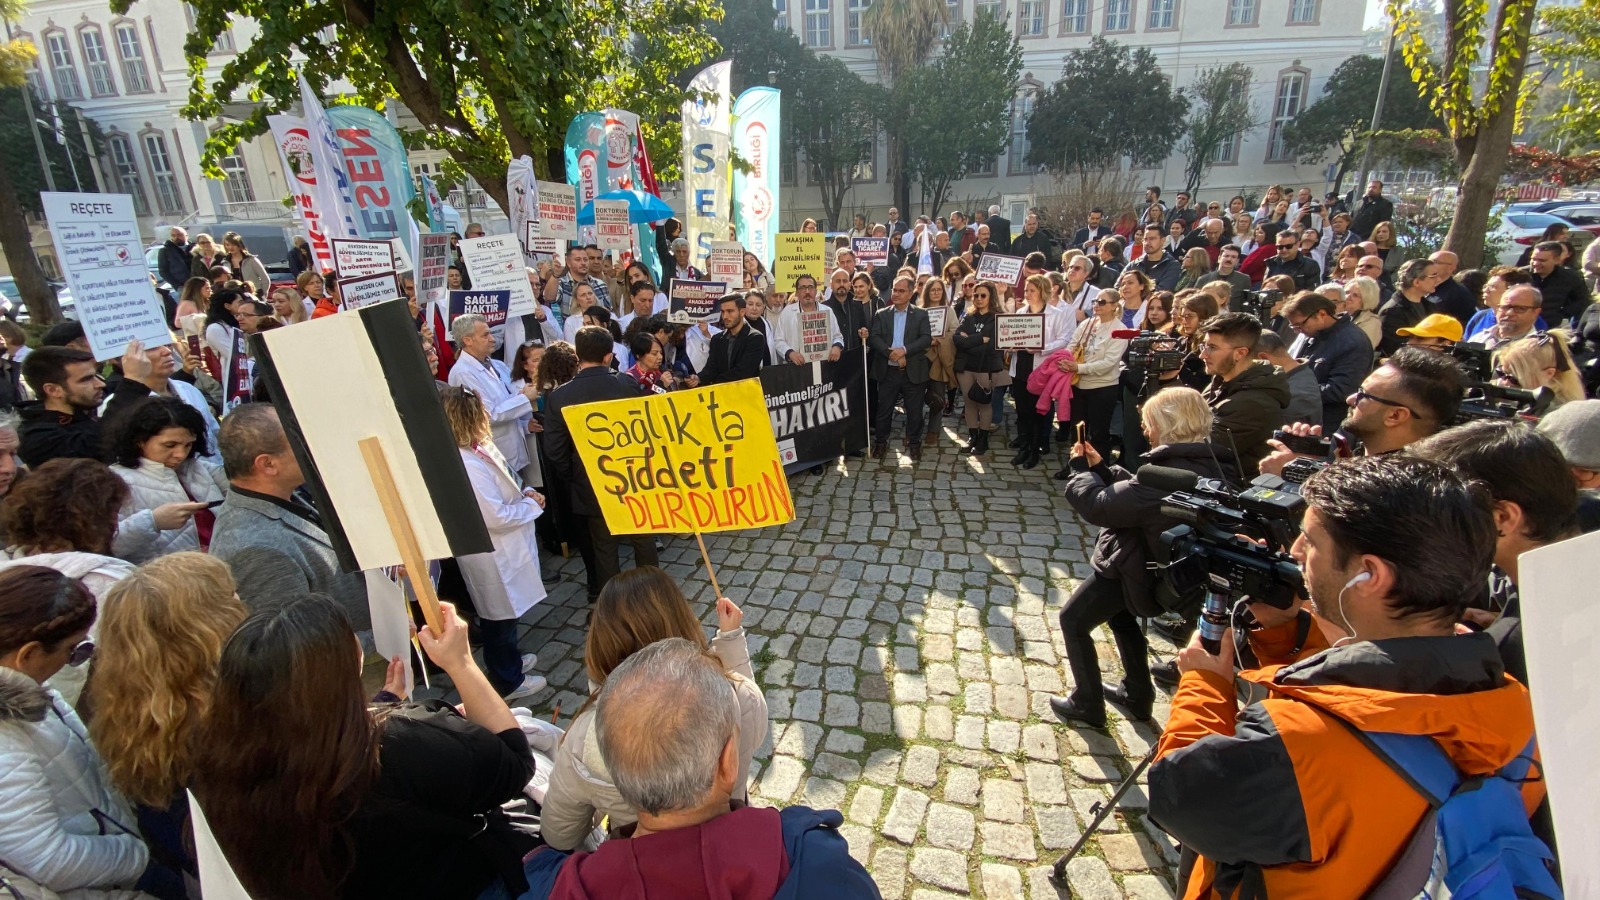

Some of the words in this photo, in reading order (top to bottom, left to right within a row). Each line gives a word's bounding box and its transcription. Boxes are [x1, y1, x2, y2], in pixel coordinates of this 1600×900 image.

[752, 134, 761, 178] BİRLİĞİ
[70, 202, 113, 216] REÇETE
[692, 143, 716, 260] SES
[540, 212, 575, 222] EYLEMDEYİZ!
[476, 240, 504, 250] REÇETE
[355, 282, 375, 291] ESKİDEN
[464, 294, 498, 305] SAĞLIK
[464, 304, 498, 314] HAKTIR
[765, 382, 833, 408] önetmeliğine
[586, 390, 744, 460] Sağlık'ta
[770, 387, 850, 438] HAYIR!
[597, 444, 735, 504] Şiddeti
[624, 459, 793, 530] DURDURUN
